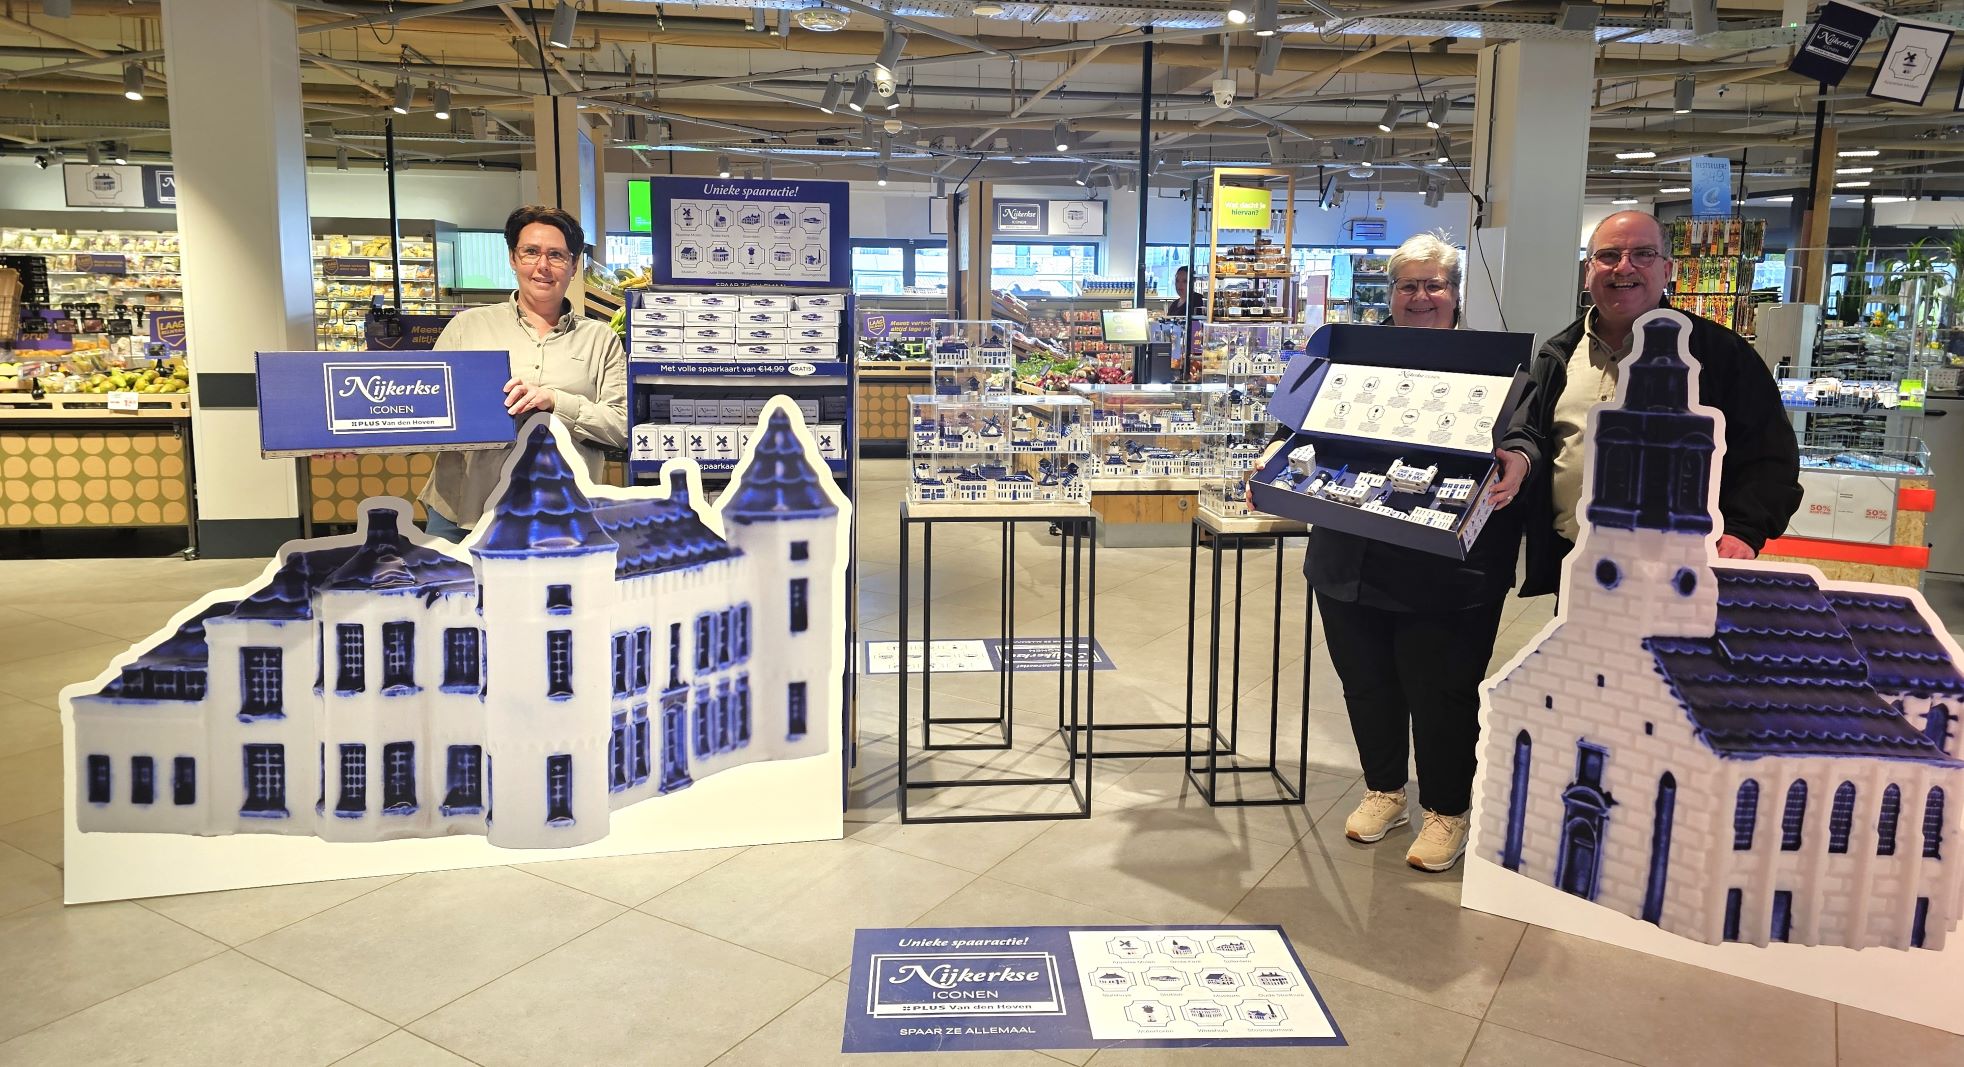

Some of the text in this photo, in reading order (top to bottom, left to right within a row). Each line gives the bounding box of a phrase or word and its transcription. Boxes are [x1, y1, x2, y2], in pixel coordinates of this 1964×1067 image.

[1816, 31, 1854, 49] Nijkerkse
[703, 183, 799, 199] Unieke spaaractie!
[1002, 208, 1037, 220] Nijkerkse
[660, 364, 675, 372] Met
[698, 365, 740, 374] spaarkaart
[339, 375, 440, 402] Nijkerkse
[370, 405, 414, 414] ICONEN
[699, 463, 736, 471] spaarkaar
[1810, 504, 1831, 512] 50%
[1866, 509, 1888, 517] 50%
[898, 937, 1029, 949] Unieke spaaractie!
[889, 964, 1039, 989] Nijkerkse
[932, 990, 999, 999] ICONEN
[900, 1026, 1036, 1036] SPAAR ZE ALLEMAAL
